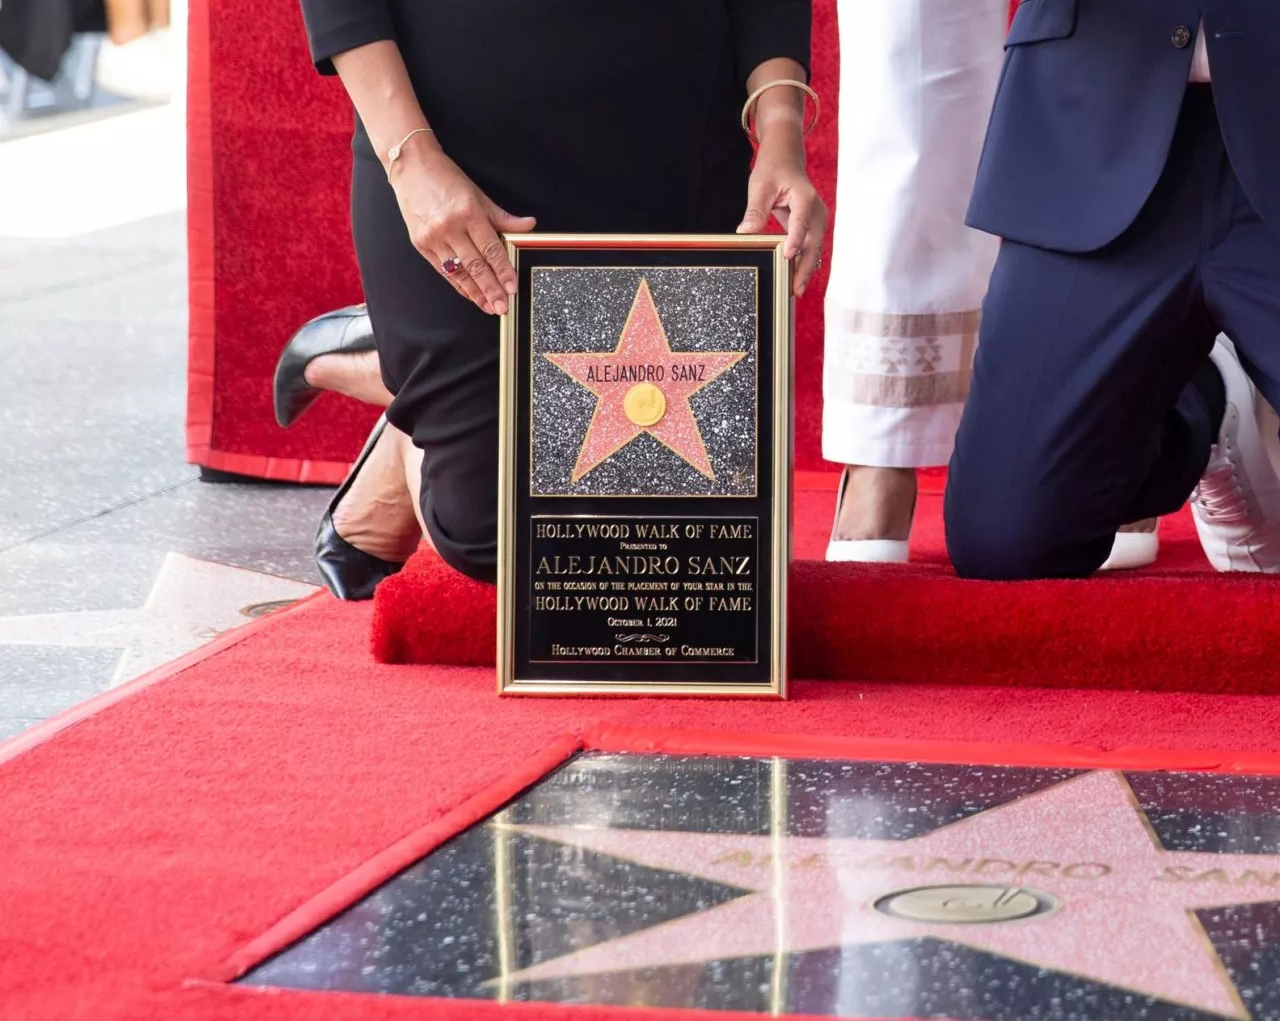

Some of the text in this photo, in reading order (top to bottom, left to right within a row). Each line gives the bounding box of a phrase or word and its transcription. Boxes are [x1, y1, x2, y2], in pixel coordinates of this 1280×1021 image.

[586, 364, 706, 382] ALEJANDRO SANZ
[536, 524, 753, 539] HOLLYWOOD WALK OF FAME
[535, 556, 751, 575] ALEJANDRO SANZ
[534, 581, 753, 591] ON THE OCCASION OF THE PLACEMENT OF YOUR STAR IN THE
[535, 596, 752, 612] HOLLYWOOD WALK OF FAME
[655, 617, 678, 627] 2021
[709, 850, 1114, 879] AANDRO
